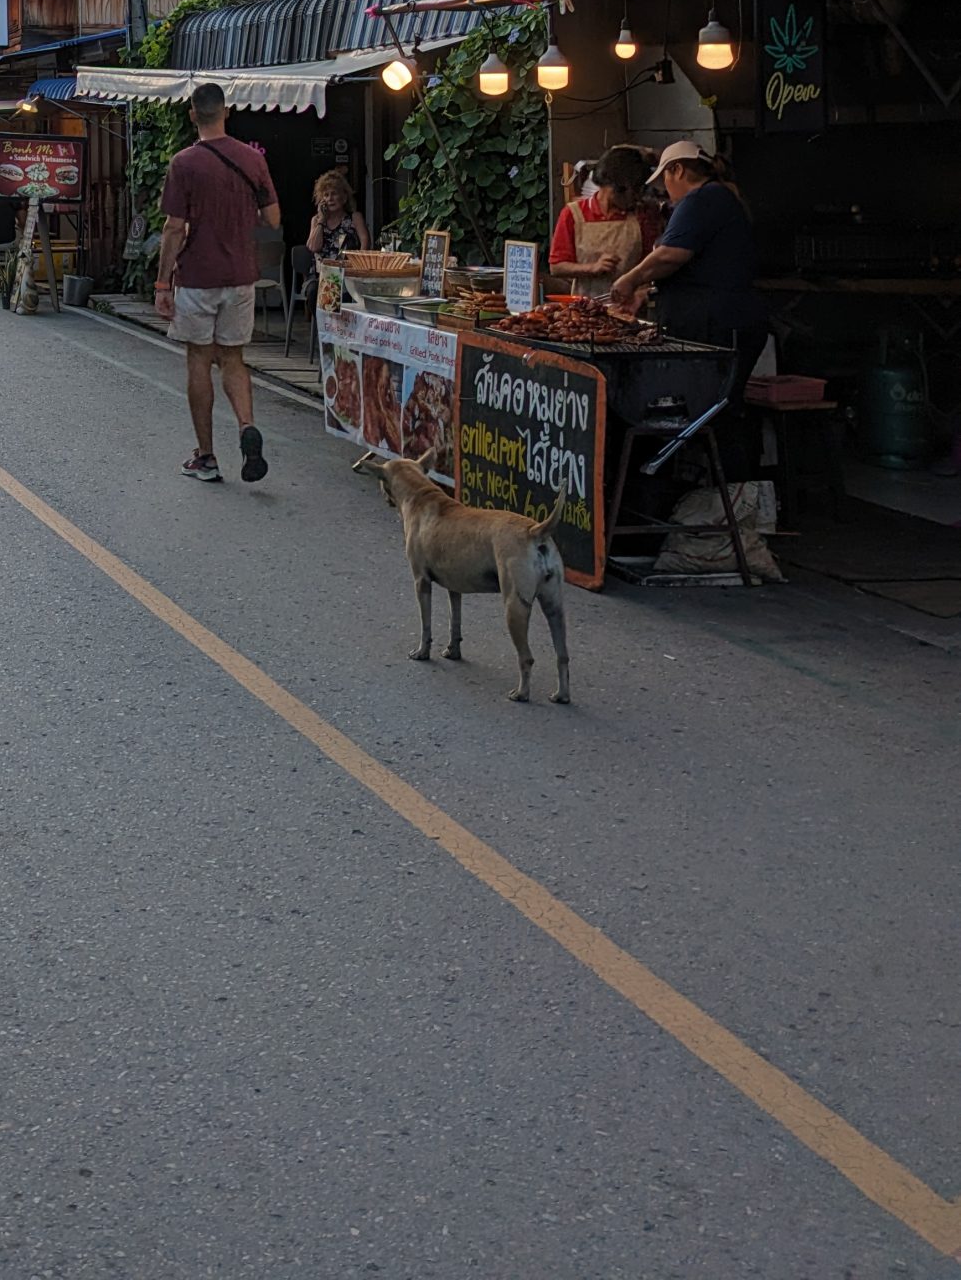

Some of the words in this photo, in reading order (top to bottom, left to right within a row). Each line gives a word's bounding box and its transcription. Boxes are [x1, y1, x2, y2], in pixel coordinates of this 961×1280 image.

[765, 71, 821, 121] Open
[2, 141, 33, 154] Banh
[13, 154, 41, 162] Sandwich
[41, 155, 73, 163] Vietnamese
[460, 420, 498, 464] Grilled
[486, 471, 519, 508] Neck
